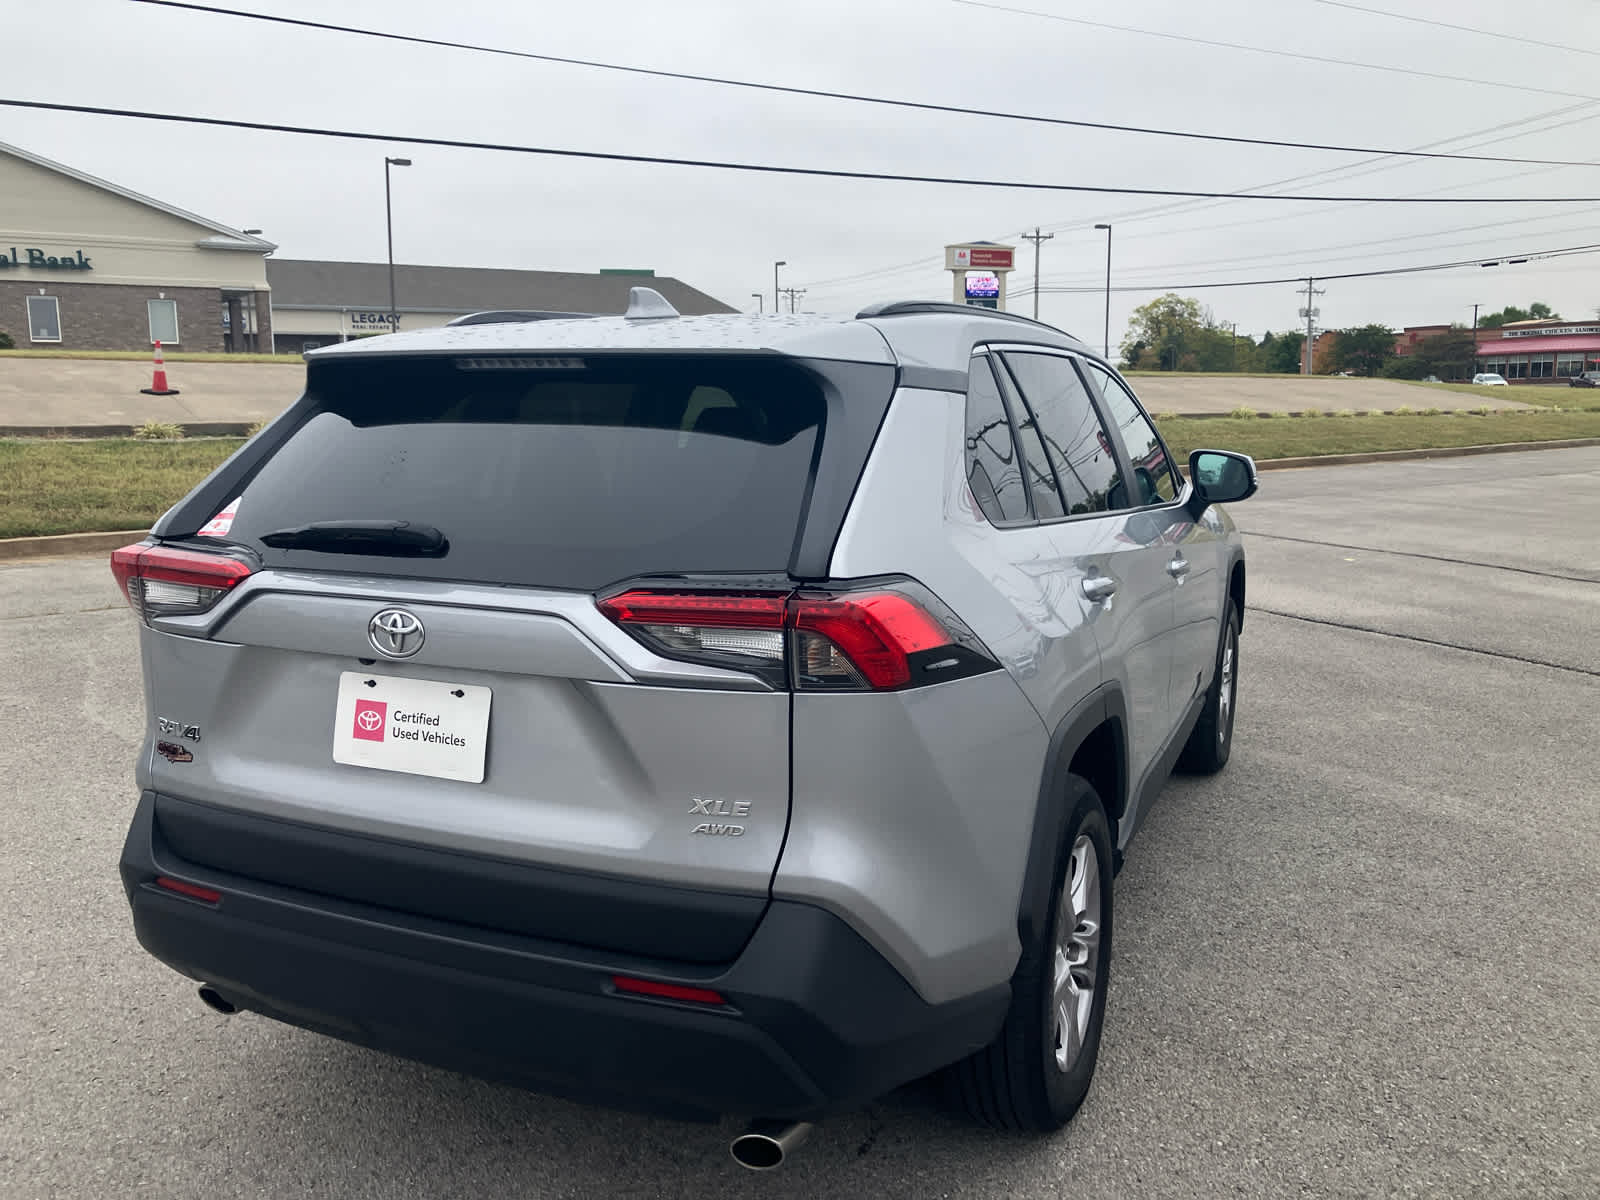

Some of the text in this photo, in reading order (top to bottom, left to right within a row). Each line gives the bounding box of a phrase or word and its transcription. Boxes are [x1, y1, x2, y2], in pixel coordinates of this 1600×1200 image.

[24, 248, 93, 270] Bank
[352, 313, 401, 323] LEGACY
[393, 710, 440, 726] Certified
[158, 716, 201, 742] RAV4
[392, 727, 466, 747] Used Vehicles
[688, 798, 752, 816] XLE
[691, 823, 745, 836] AWD
